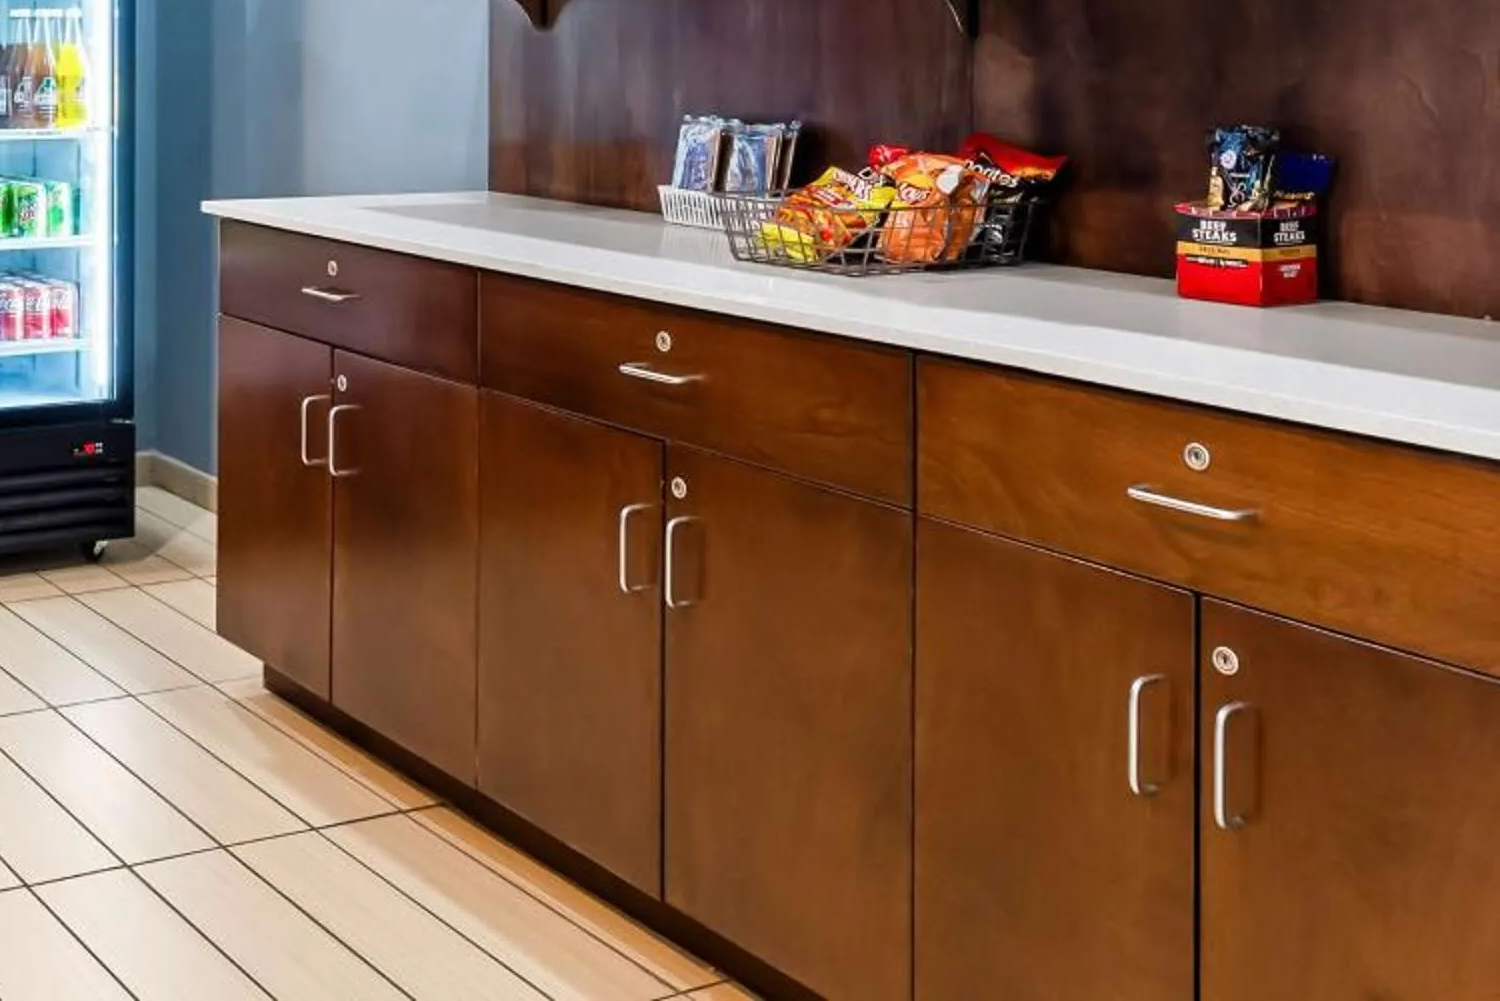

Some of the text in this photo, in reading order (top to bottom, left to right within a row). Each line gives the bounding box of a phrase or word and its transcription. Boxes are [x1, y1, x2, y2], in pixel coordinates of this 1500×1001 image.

[1200, 220, 1227, 231] BEEF
[1191, 228, 1237, 243] STEAKS
[1273, 230, 1306, 243] STEAKS
